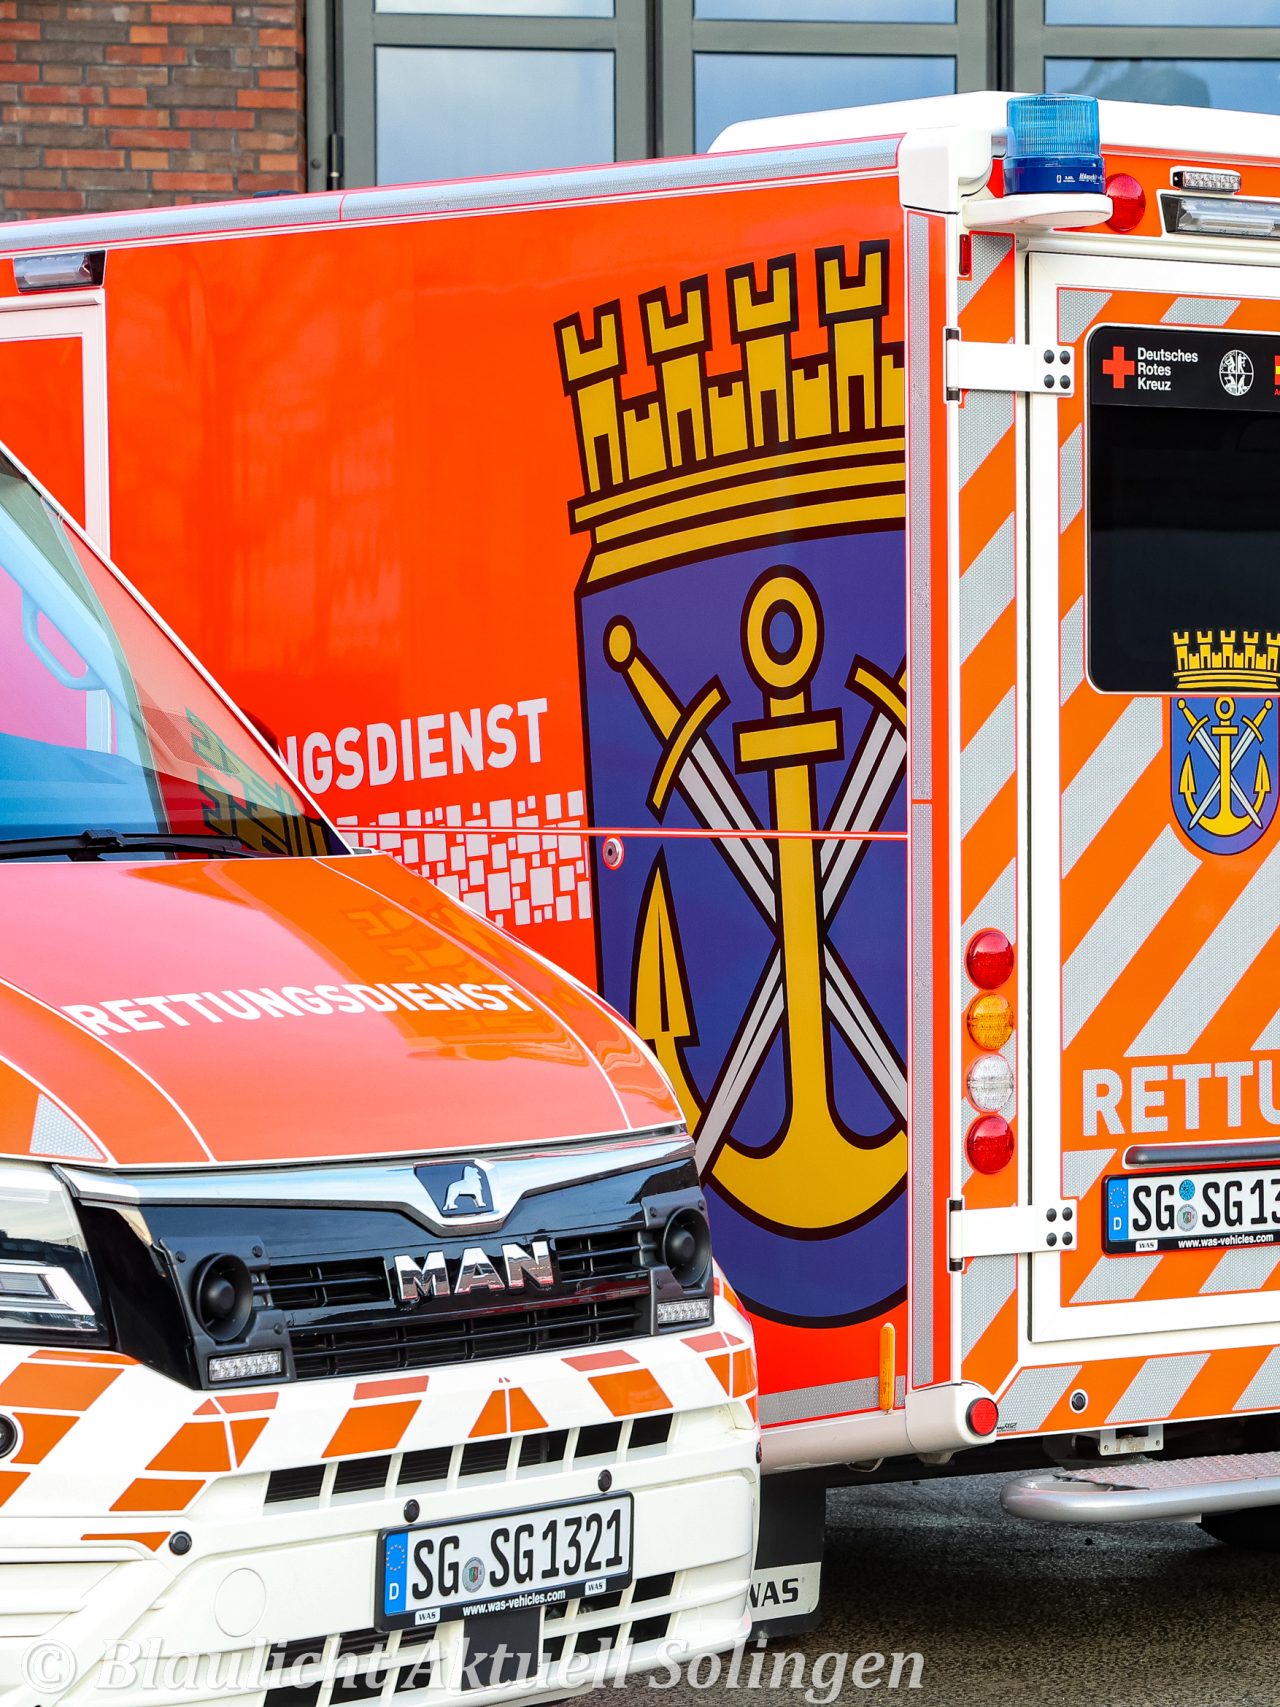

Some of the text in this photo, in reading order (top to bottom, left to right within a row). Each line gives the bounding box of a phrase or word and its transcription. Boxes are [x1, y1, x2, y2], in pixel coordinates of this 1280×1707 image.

[1137, 347, 1198, 362] Deutsches
[1137, 362, 1171, 376] Rotes
[1137, 376, 1172, 391] Kreuz
[63, 983, 535, 1036] RETTUNGSDIENST
[1113, 1217, 1122, 1231] D
[1178, 1233, 1274, 1249] www.was-vehicles.com
[394, 1240, 554, 1301] MAN
[388, 1582, 400, 1601] D
[418, 1582, 604, 1622] WAS www.was-vehicles.com WAS
